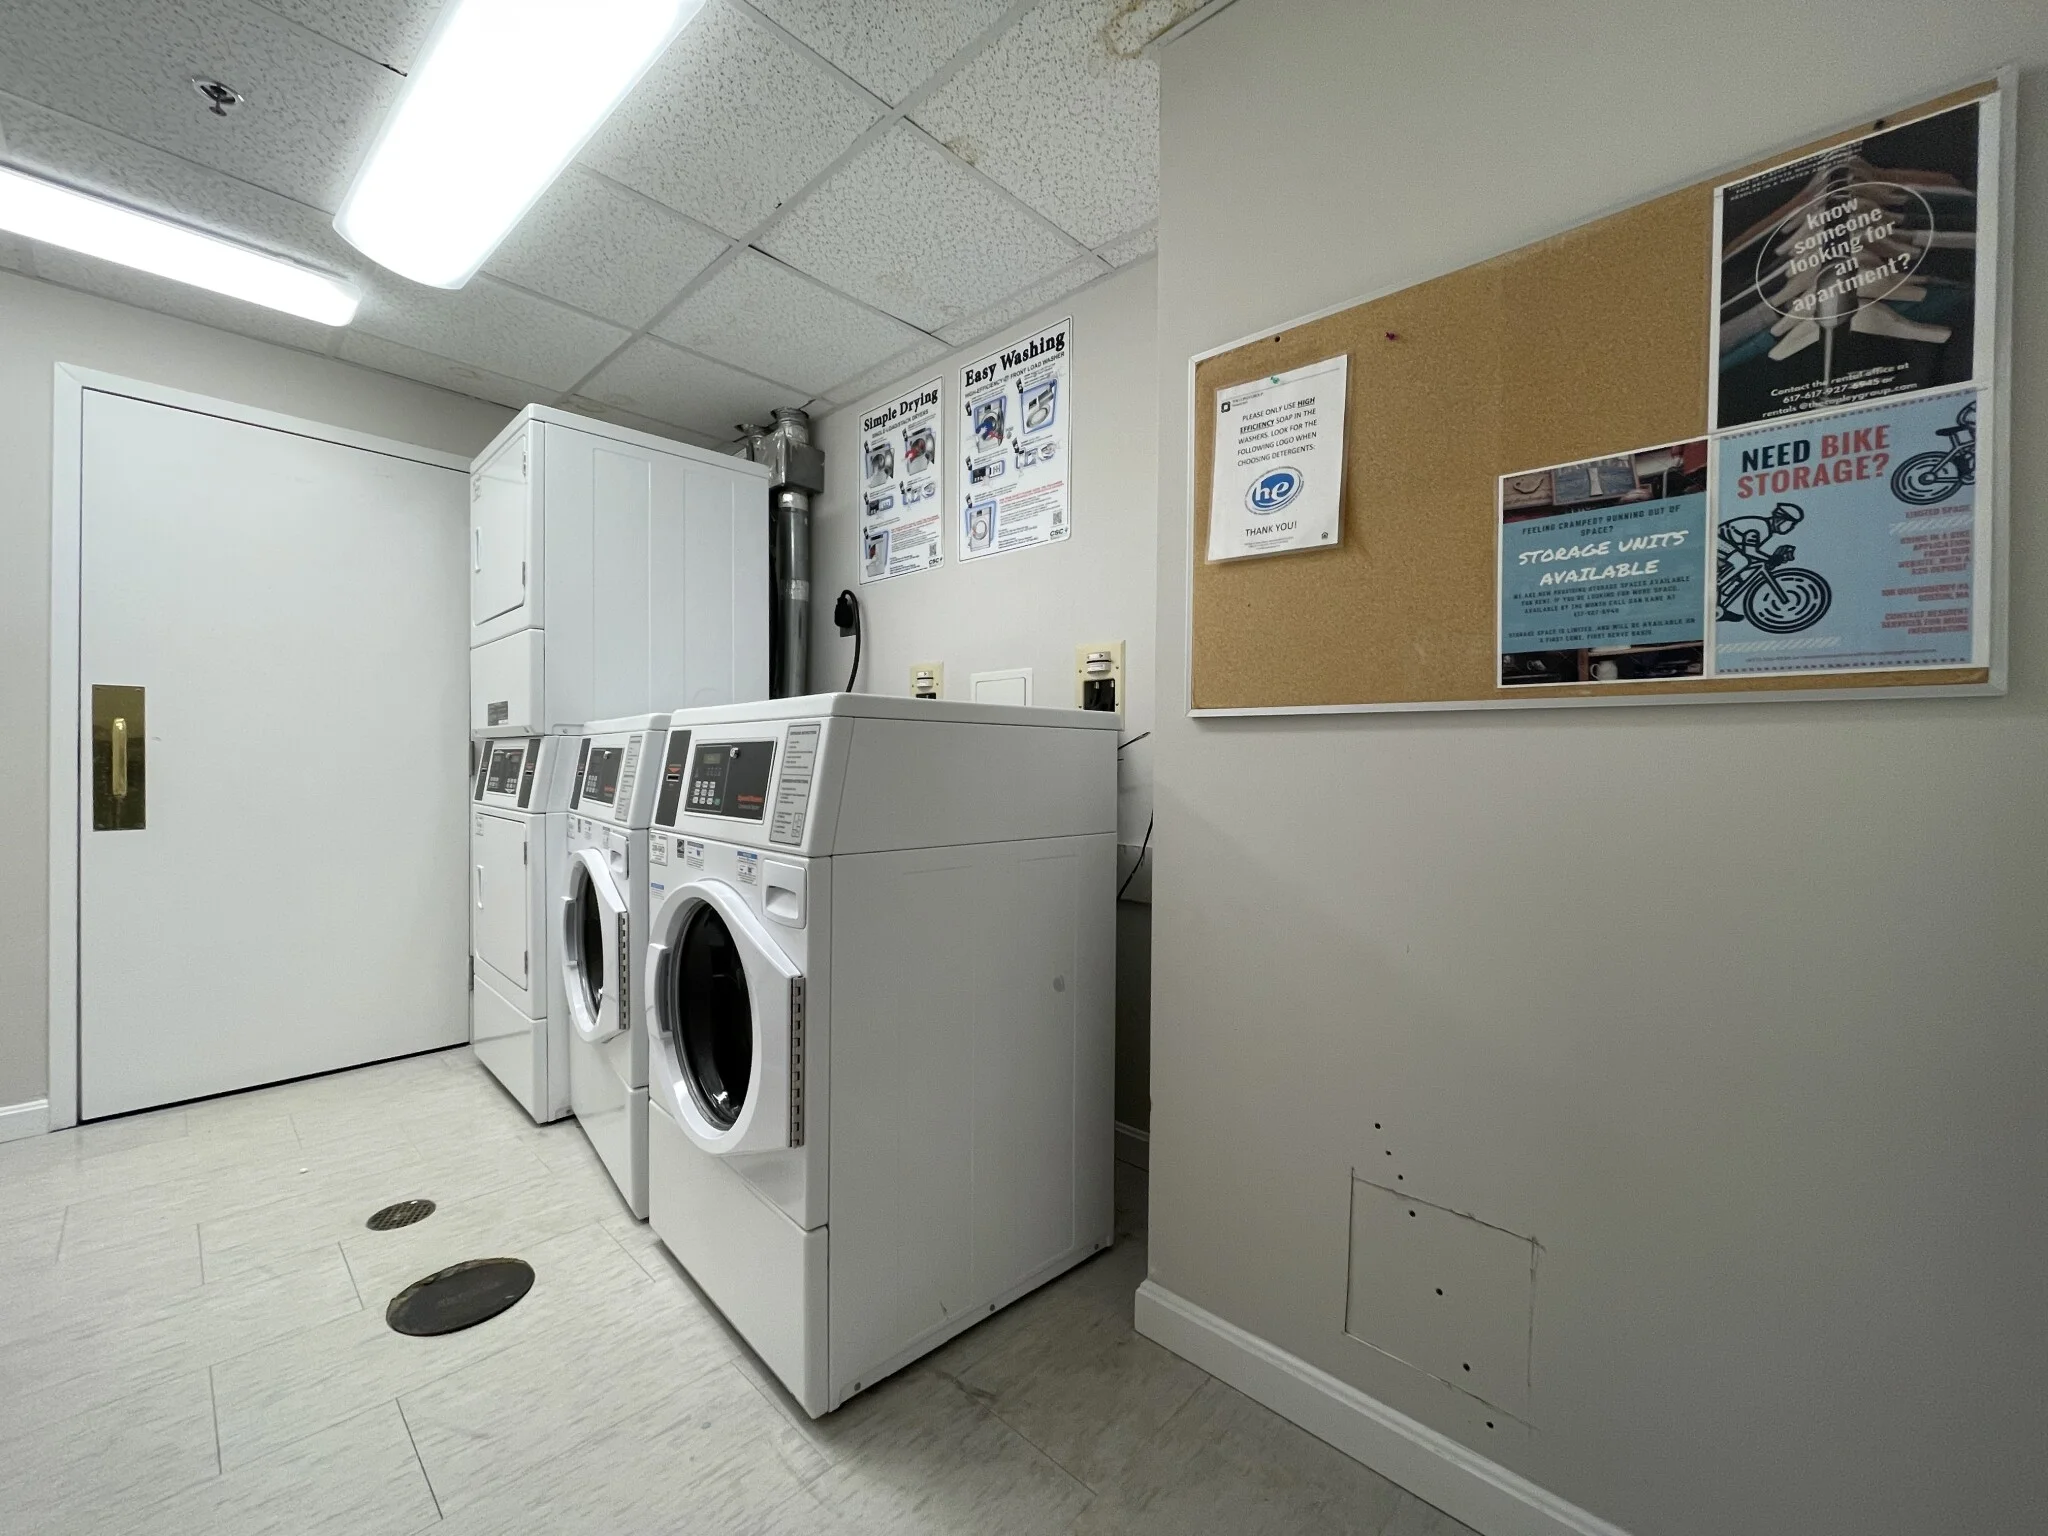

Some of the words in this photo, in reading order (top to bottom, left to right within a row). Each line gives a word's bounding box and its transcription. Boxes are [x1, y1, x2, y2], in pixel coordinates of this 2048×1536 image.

[1806, 198, 1858, 229] know
[1794, 208, 1882, 254] someone
[1790, 236, 1863, 275] looking
[1865, 221, 1895, 243] for
[1835, 257, 1859, 276] an
[1793, 253, 1911, 312] apartment?
[965, 363, 997, 387] Easy
[1000, 332, 1065, 371] Washing
[1010, 368, 1026, 380] FRONT
[1027, 361, 1041, 372] LOAD
[1042, 351, 1065, 365] WASHER
[1770, 383, 1810, 397] Contact
[1897, 362, 1909, 371] at
[864, 407, 897, 432] Simple
[900, 389, 938, 416] Drying
[1240, 419, 1275, 434] EFFICIENCY
[1276, 414, 1293, 424] SOAP
[1303, 408, 1316, 417] THE
[1242, 411, 1264, 422] PLEASE
[1265, 406, 1283, 416] ONLY
[1284, 401, 1296, 410] USE
[1297, 396, 1316, 409] HIGH
[1762, 406, 1797, 418] rentals
[1271, 427, 1288, 437] LOOK
[1289, 423, 1303, 431] FOR
[1305, 419, 1317, 428] THE
[1237, 442, 1274, 456] FOLLOWING
[1276, 437, 1294, 447] LOGO
[1295, 432, 1317, 442] WHEN
[1742, 439, 1811, 473] NEED
[1821, 424, 1891, 459] BIKE
[1237, 454, 1271, 467] CHOOSING
[1737, 452, 1890, 499] STORAGE?
[1255, 480, 1290, 502] he
[1245, 525, 1273, 537] THANK
[1275, 521, 1297, 531] YOU!
[1522, 524, 1555, 535] FEELING
[1559, 517, 1603, 530] CRAMPED?
[1607, 511, 1644, 523] RUNNING
[1648, 508, 1665, 517] OUT
[1669, 504, 1681, 513] OF
[1580, 526, 1614, 537] SPACE?
[1518, 541, 1611, 566] STORAGE
[1618, 530, 1689, 553] UNITS
[1539, 559, 1660, 587] AVAILABLE
[1620, 580, 1647, 589] SPACES
[1649, 576, 1691, 586] AVAILABLE
[1525, 605, 1558, 614] AVAILABLE
[1609, 599, 1626, 607] CALL
[1587, 592, 1615, 600] LOOKING
[1537, 628, 1556, 636] SPACE
[1613, 622, 1629, 630] WILL
[1642, 619, 1682, 628] AVAILABLE
[1546, 635, 1563, 643] FIRST
